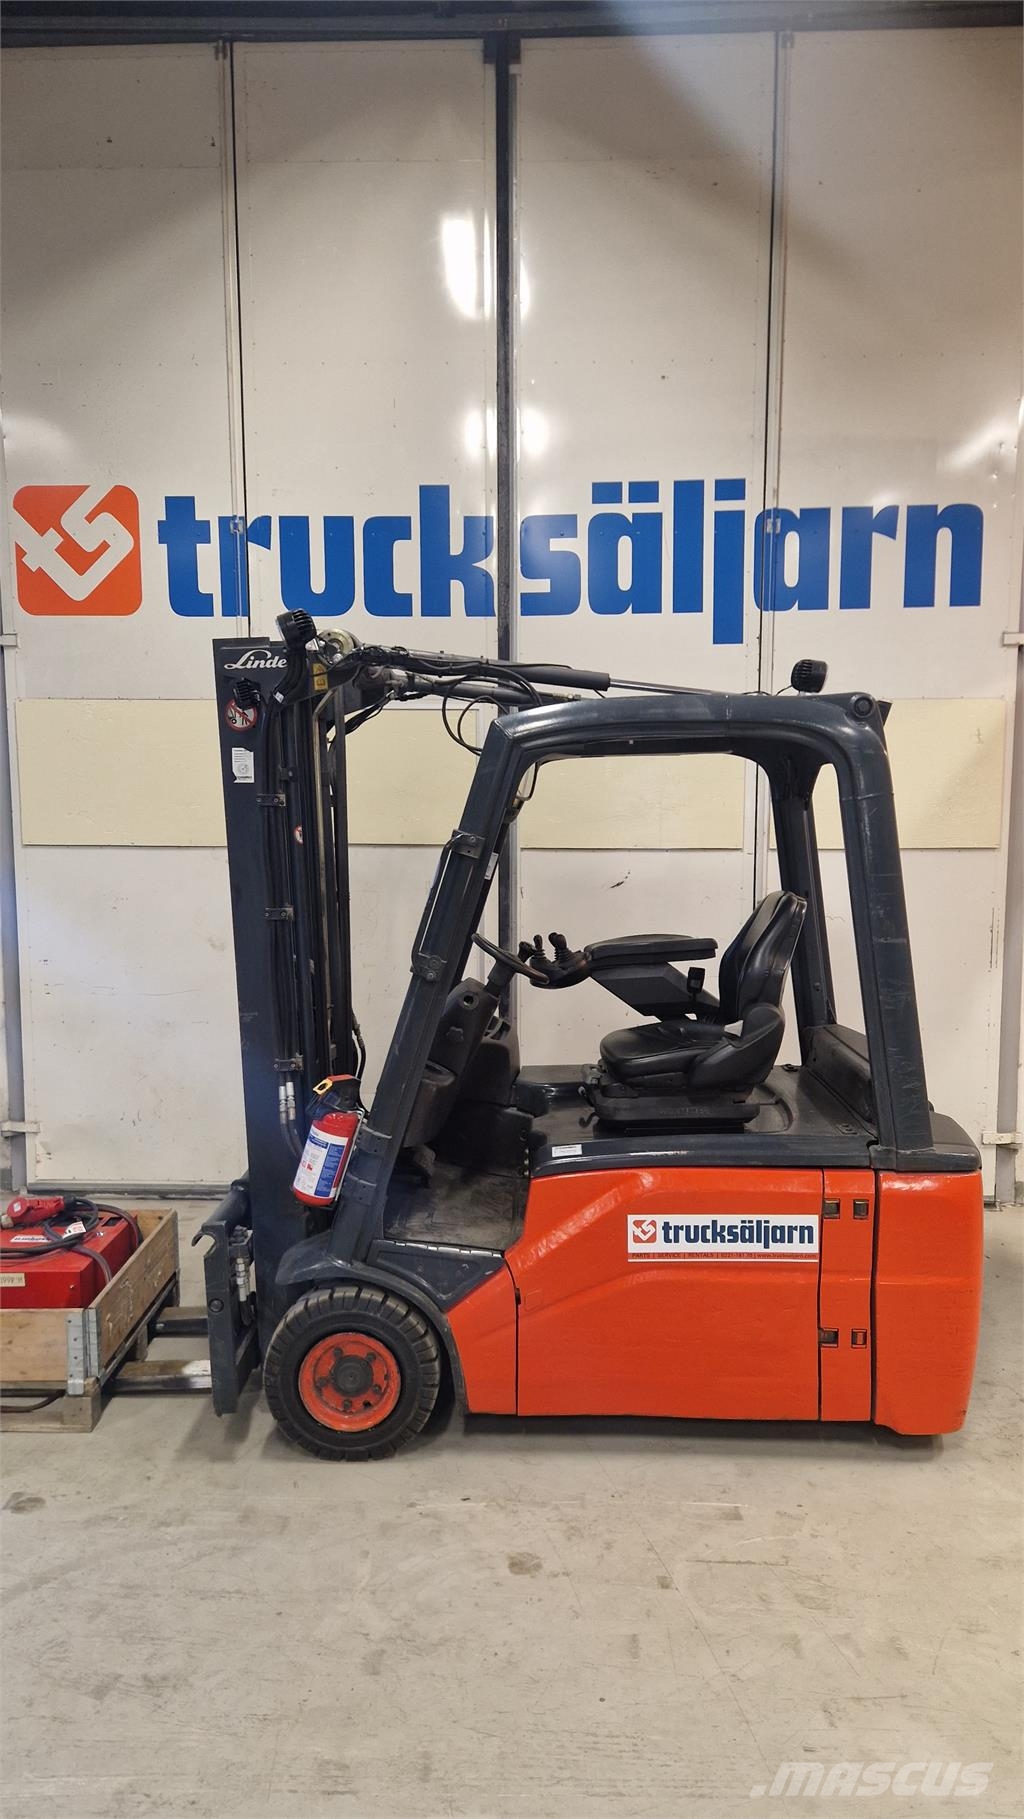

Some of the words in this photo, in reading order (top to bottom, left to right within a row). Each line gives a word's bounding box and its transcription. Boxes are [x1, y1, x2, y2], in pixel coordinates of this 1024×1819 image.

[157, 478, 984, 645] trucksäljarn
[224, 649, 288, 670] Linde
[662, 1219, 814, 1249] trucksäljarn
